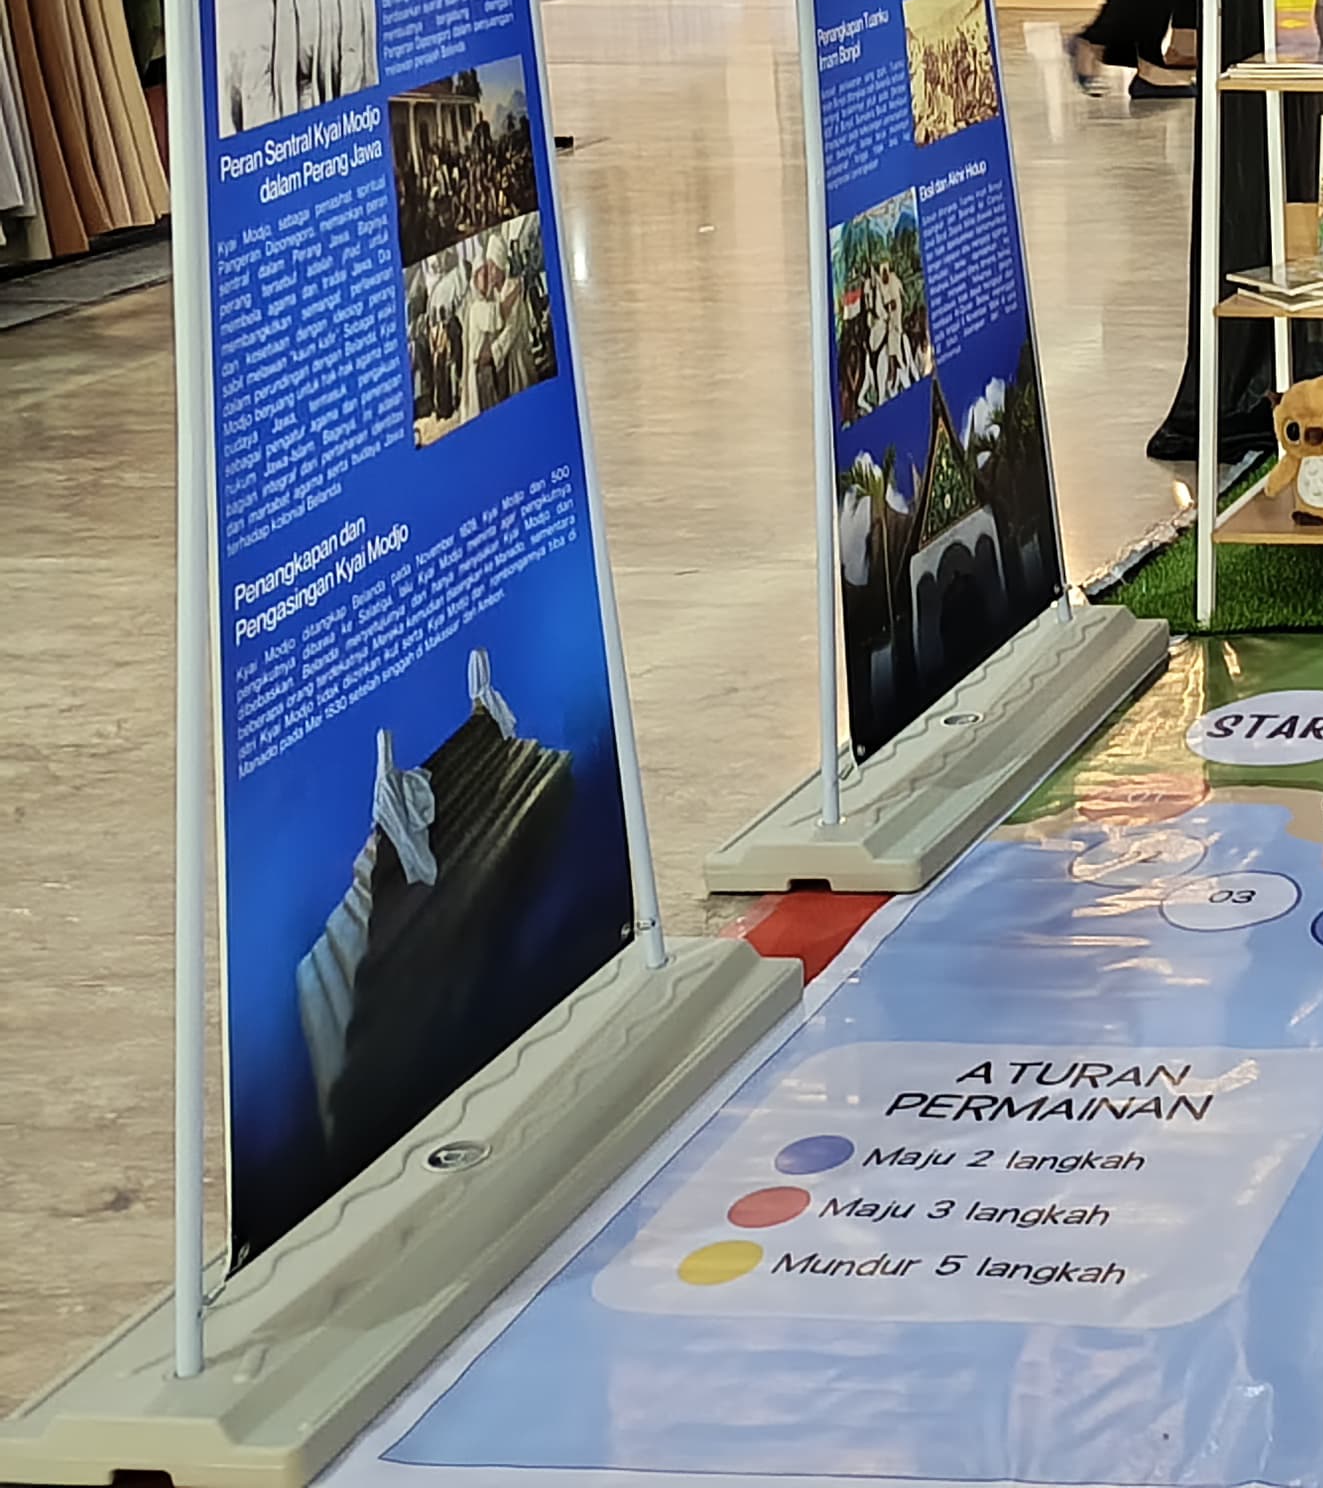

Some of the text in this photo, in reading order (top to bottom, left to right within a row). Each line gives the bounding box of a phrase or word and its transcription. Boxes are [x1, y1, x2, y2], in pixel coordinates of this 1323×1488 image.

[220, 104, 381, 183] Peran Sentral Kyai Modjo
[259, 140, 383, 204] dalam Perang Jawa
[234, 515, 366, 610] Penangkapan dan
[235, 521, 410, 646] Pengasingan Kyai Modjo
[1208, 887, 1257, 905] 03
[954, 1060, 1193, 1090] ATURAN
[884, 1092, 1214, 1123] PERMAINAN
[862, 1146, 1147, 1175] Maju 2 langkah
[818, 1196, 1113, 1229] Maju 3 langkah
[770, 1251, 1129, 1288] Mundur 5 langkah
